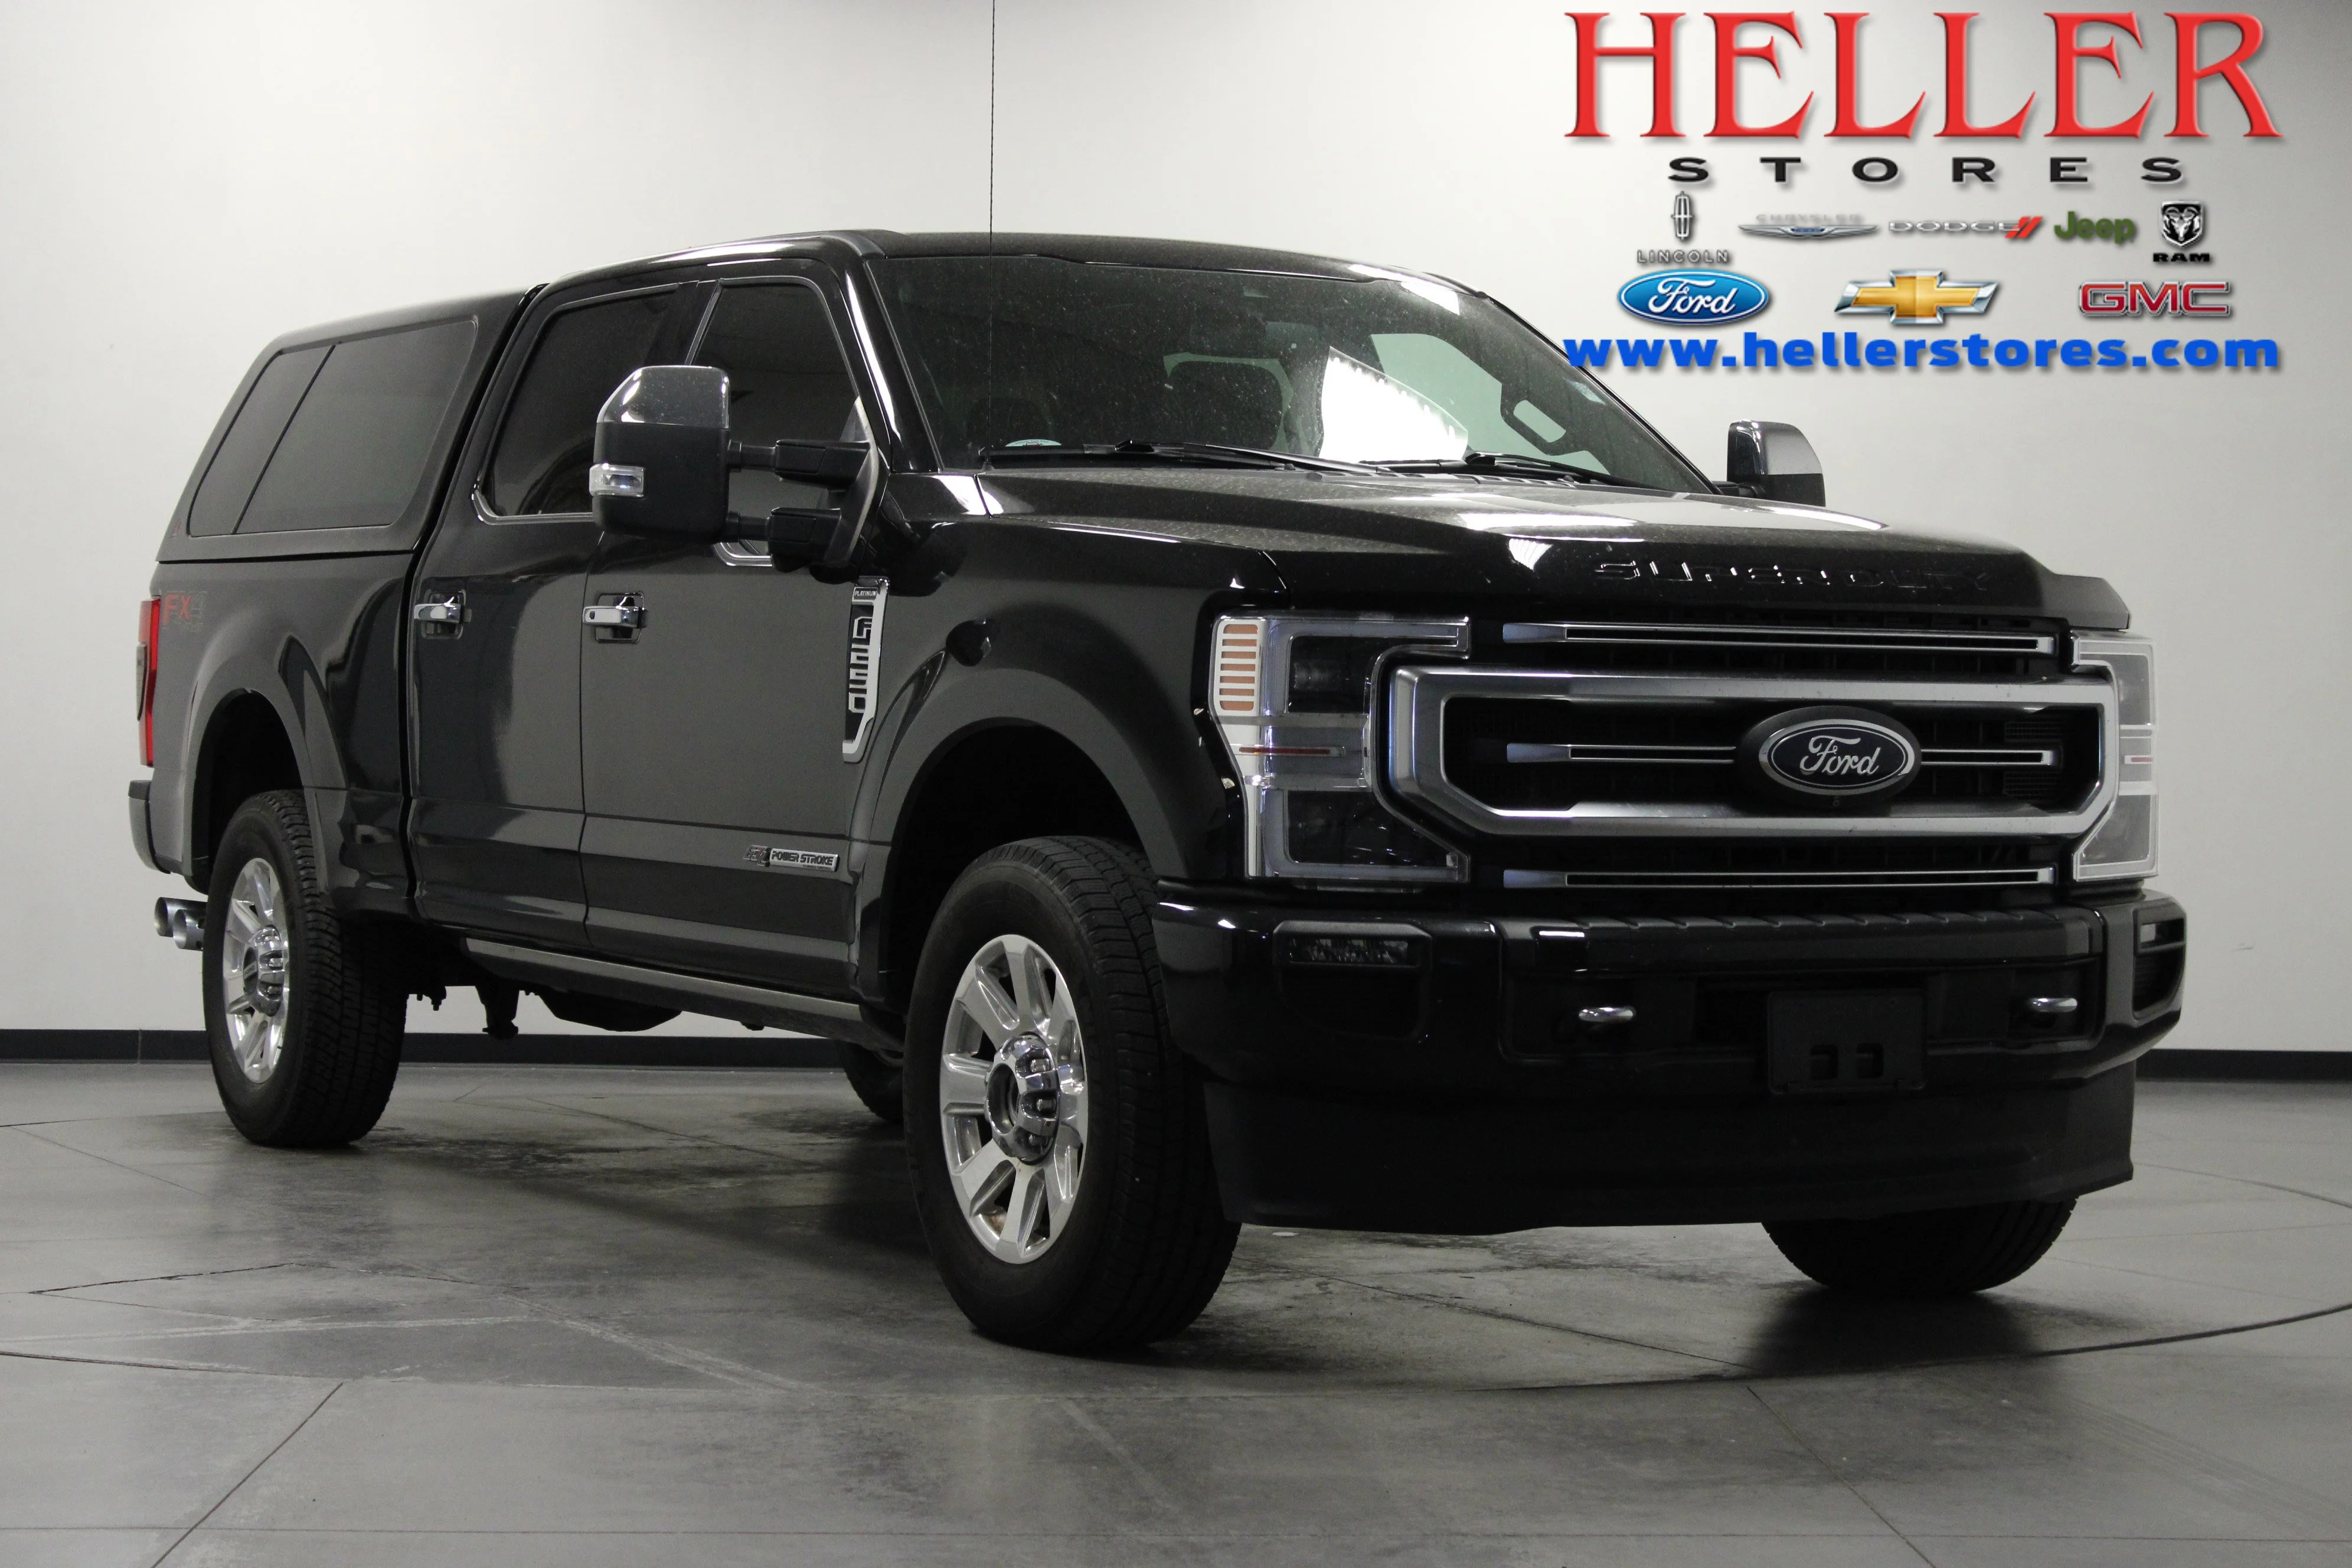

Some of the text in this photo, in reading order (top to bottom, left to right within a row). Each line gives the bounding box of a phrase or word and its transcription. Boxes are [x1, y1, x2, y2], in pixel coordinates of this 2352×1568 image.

[1799, 734, 1881, 775] Ford
[771, 850, 834, 866] POWER STROKE
